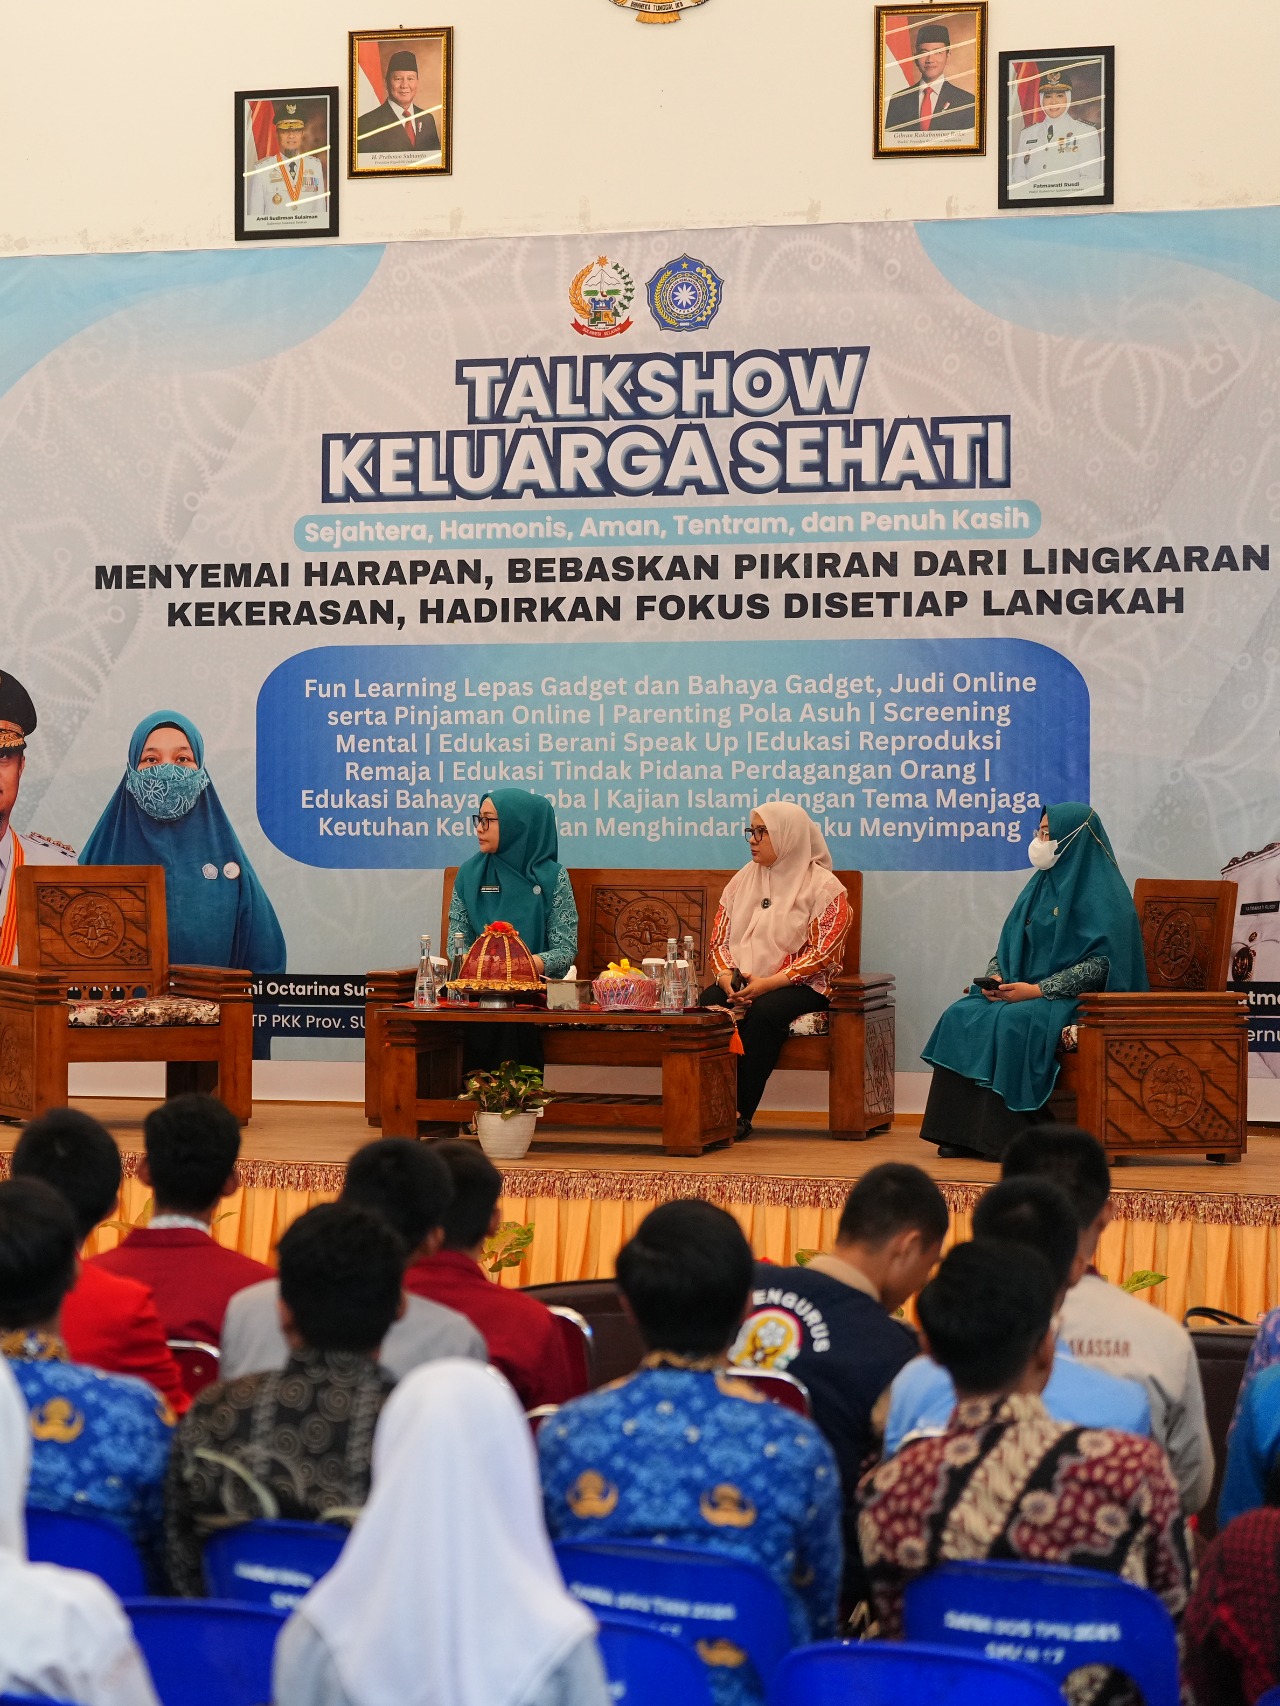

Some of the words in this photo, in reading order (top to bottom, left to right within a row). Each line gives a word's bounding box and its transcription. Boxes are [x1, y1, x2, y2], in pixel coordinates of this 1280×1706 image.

[457, 346, 870, 424] TALKSHOW
[323, 424, 727, 503] KELUARGA
[732, 415, 1010, 494] SEHATI
[305, 520, 434, 551] Sejahtera,
[441, 516, 573, 540] Harmonis,
[580, 517, 666, 538] Aman,
[674, 515, 795, 536] Tentram,
[802, 512, 854, 532] dan
[861, 509, 945, 531] Penuh
[953, 506, 1029, 529] Kasih
[95, 563, 289, 589] MENYEMAI
[305, 559, 492, 590] HARAPAN,
[508, 555, 718, 583] BEBASKAN
[735, 552, 897, 579] PIKIRAN
[915, 550, 1006, 576] DARI
[1024, 545, 1269, 574] LINGKARAN
[168, 600, 405, 630] KEKERASAN,
[420, 596, 620, 623] HADIRKAN
[637, 594, 769, 620] FOKUS
[785, 591, 967, 618] DISETIAP
[984, 587, 1183, 616] LANGKAH
[306, 680, 346, 697] Fun
[355, 677, 457, 702] Learning
[465, 678, 533, 701] Lepas
[541, 676, 627, 701] Gadget
[635, 675, 679, 695] dan
[689, 675, 777, 699] Bahaya
[786, 674, 882, 699] Gadget,
[890, 672, 943, 693] Judi
[953, 672, 1036, 692] Online
[328, 708, 387, 725] serta
[396, 705, 503, 730] Pinjaman
[512, 704, 590, 724] Online
[614, 703, 731, 728] Parenting
[740, 703, 792, 722] Pola
[800, 702, 860, 722] Asuh
[884, 701, 1010, 726] Screening
[337, 733, 417, 752] Mental
[440, 733, 529, 752] Edukasi
[539, 732, 615, 752] Berani
[624, 732, 696, 756] Speak
[706, 732, 738, 756] Up
[860, 730, 1000, 756] Reproduksi
[346, 761, 431, 786] Remaja
[454, 760, 543, 780] Edukasi
[551, 760, 631, 780] Tindak
[640, 760, 723, 779] Pidana
[732, 760, 891, 785] Perdagangan
[901, 760, 976, 784] Orang
[302, 789, 388, 808] Edukasi
[395, 789, 480, 814] Bahaya
[608, 788, 679, 813] Kajian
[686, 787, 758, 808] Islami
[862, 789, 928, 808] Tema
[937, 788, 1041, 813] Menjaga
[320, 817, 428, 836] Keutuhan
[555, 817, 588, 836] an
[596, 816, 746, 842] Menghindari
[860, 817, 1021, 842] Menyimpang
[266, 982, 339, 996] Octarina
[272, 1015, 301, 1028] PKK
[306, 1016, 346, 1028] Prov.
[752, 1287, 831, 1353] ENGURUS
[1070, 1340, 1131, 1358] KASSAR
